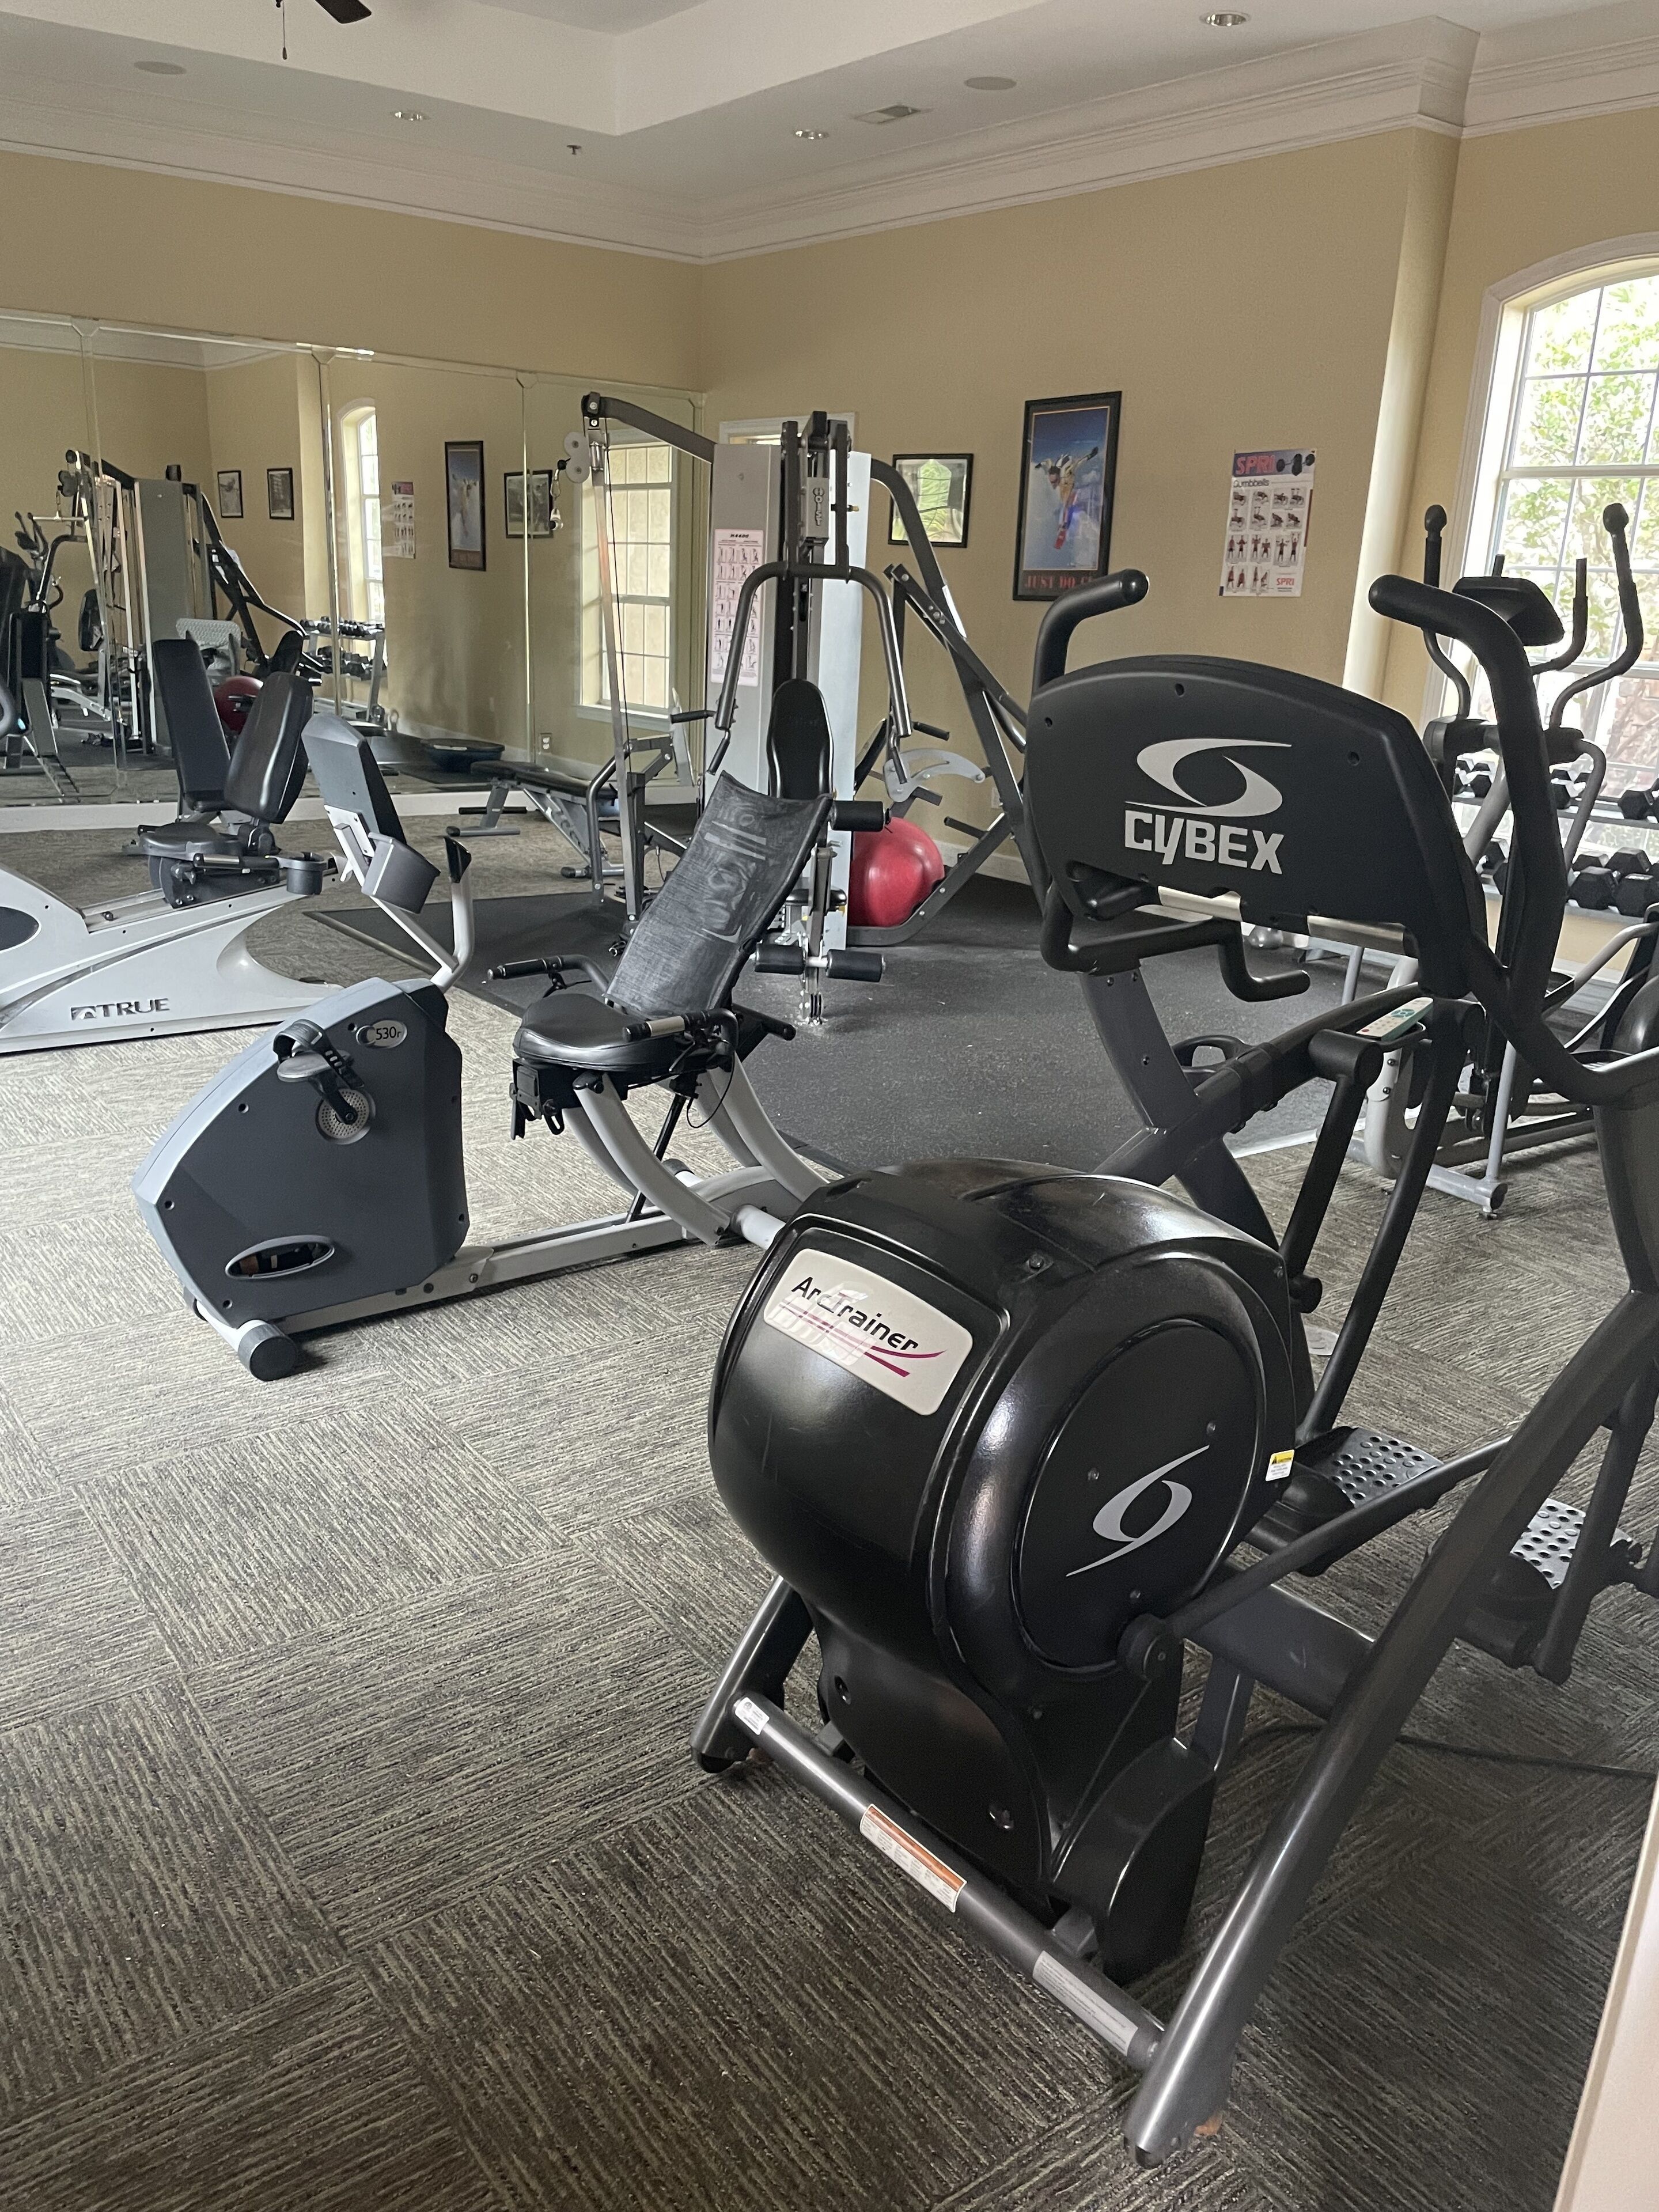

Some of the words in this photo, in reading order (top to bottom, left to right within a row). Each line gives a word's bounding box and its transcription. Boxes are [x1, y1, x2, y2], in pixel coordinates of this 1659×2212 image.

[1235, 454, 1276, 475] SPRI
[813, 487, 824, 526] HOIST
[1024, 575, 1053, 589] JUST
[1059, 576, 1076, 588] DO
[1277, 578, 1295, 586] SPRI
[1124, 809, 1285, 875] CYBEX
[96, 998, 170, 1017] TRUE
[376, 1026, 402, 1040] 530r
[791, 1276, 919, 1351] ArcTrainer
